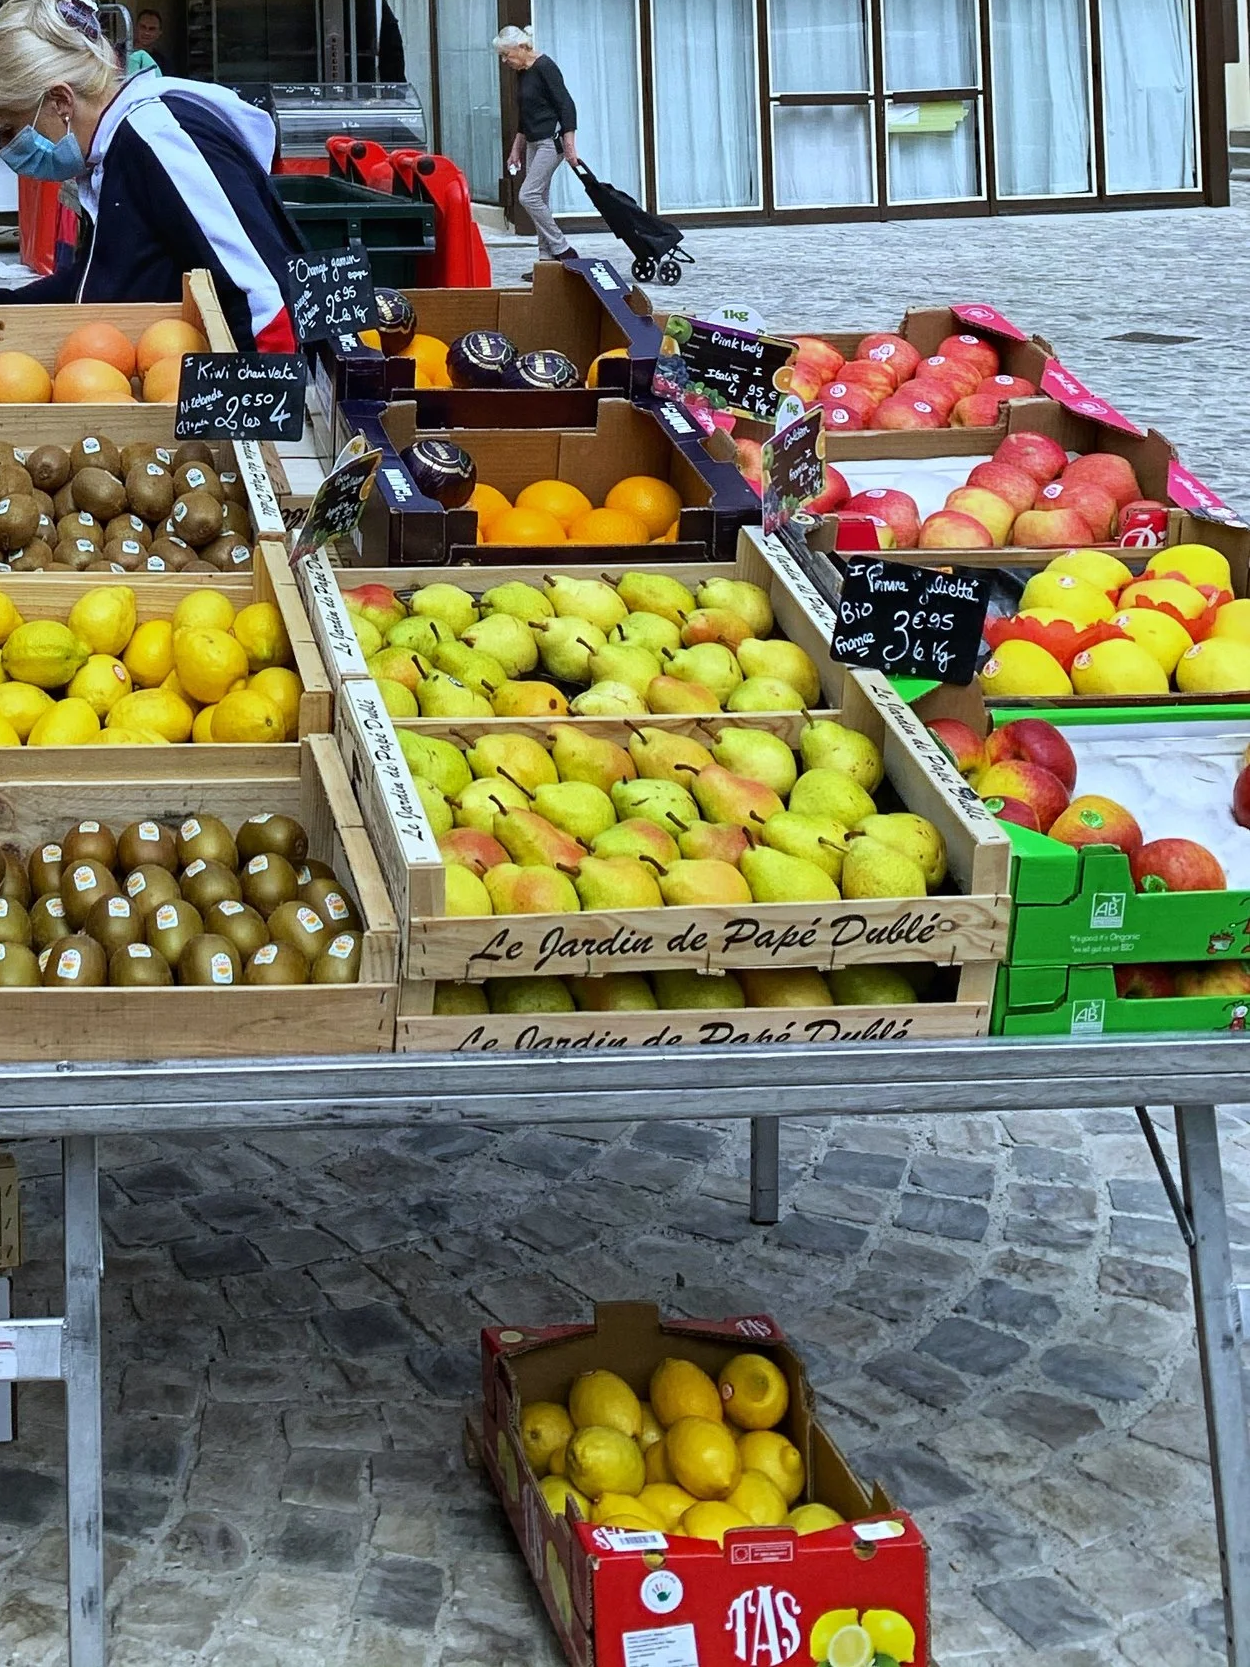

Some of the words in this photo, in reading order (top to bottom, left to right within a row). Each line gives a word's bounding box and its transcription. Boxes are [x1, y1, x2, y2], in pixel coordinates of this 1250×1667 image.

[722, 309, 749, 322] 1kg
[197, 361, 230, 381] Kiwi
[841, 601, 873, 625] Bio
[870, 684, 895, 700] Le
[356, 698, 384, 730] Dublé
[876, 702, 918, 736] Jardin
[369, 731, 397, 763] Papé
[912, 737, 932, 752] de
[382, 765, 401, 779] de
[922, 754, 962, 784] Papé
[390, 783, 423, 820] Jardin
[400, 823, 424, 842] Le
[1095, 900, 1119, 918] AB
[471, 928, 523, 962] Le
[534, 926, 654, 971] Jardin
[667, 922, 709, 953] de
[722, 917, 817, 962] Papé
[830, 911, 941, 947] Dublé
[1075, 1006, 1098, 1023] AB
[453, 1026, 499, 1051] Le
[508, 1024, 628, 1051] Jardin
[642, 1026, 683, 1047] de
[805, 1018, 913, 1043] Dublé
[725, 1585, 801, 1667] TAS
